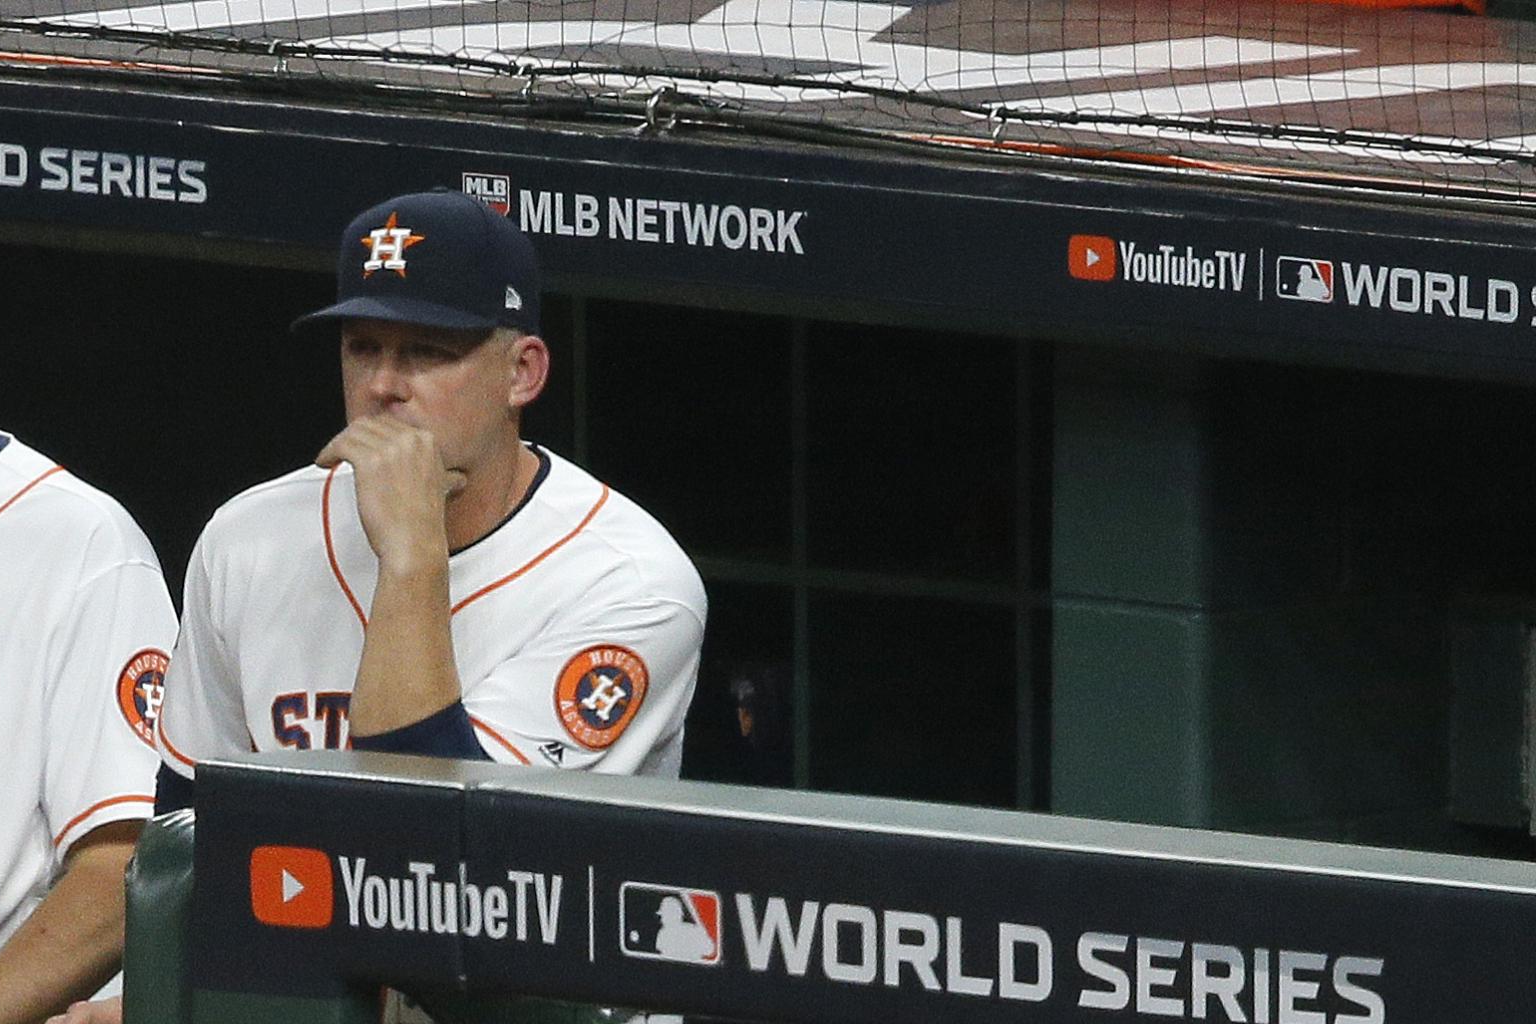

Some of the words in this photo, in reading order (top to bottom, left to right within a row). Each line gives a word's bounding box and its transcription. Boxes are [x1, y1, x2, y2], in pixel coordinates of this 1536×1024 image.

[39, 147, 208, 204] SERIES
[519, 189, 600, 237] MLB
[608, 196, 804, 254] NETWORK
[1341, 261, 1519, 324] WORLD
[735, 893, 1053, 1002] WORLD
